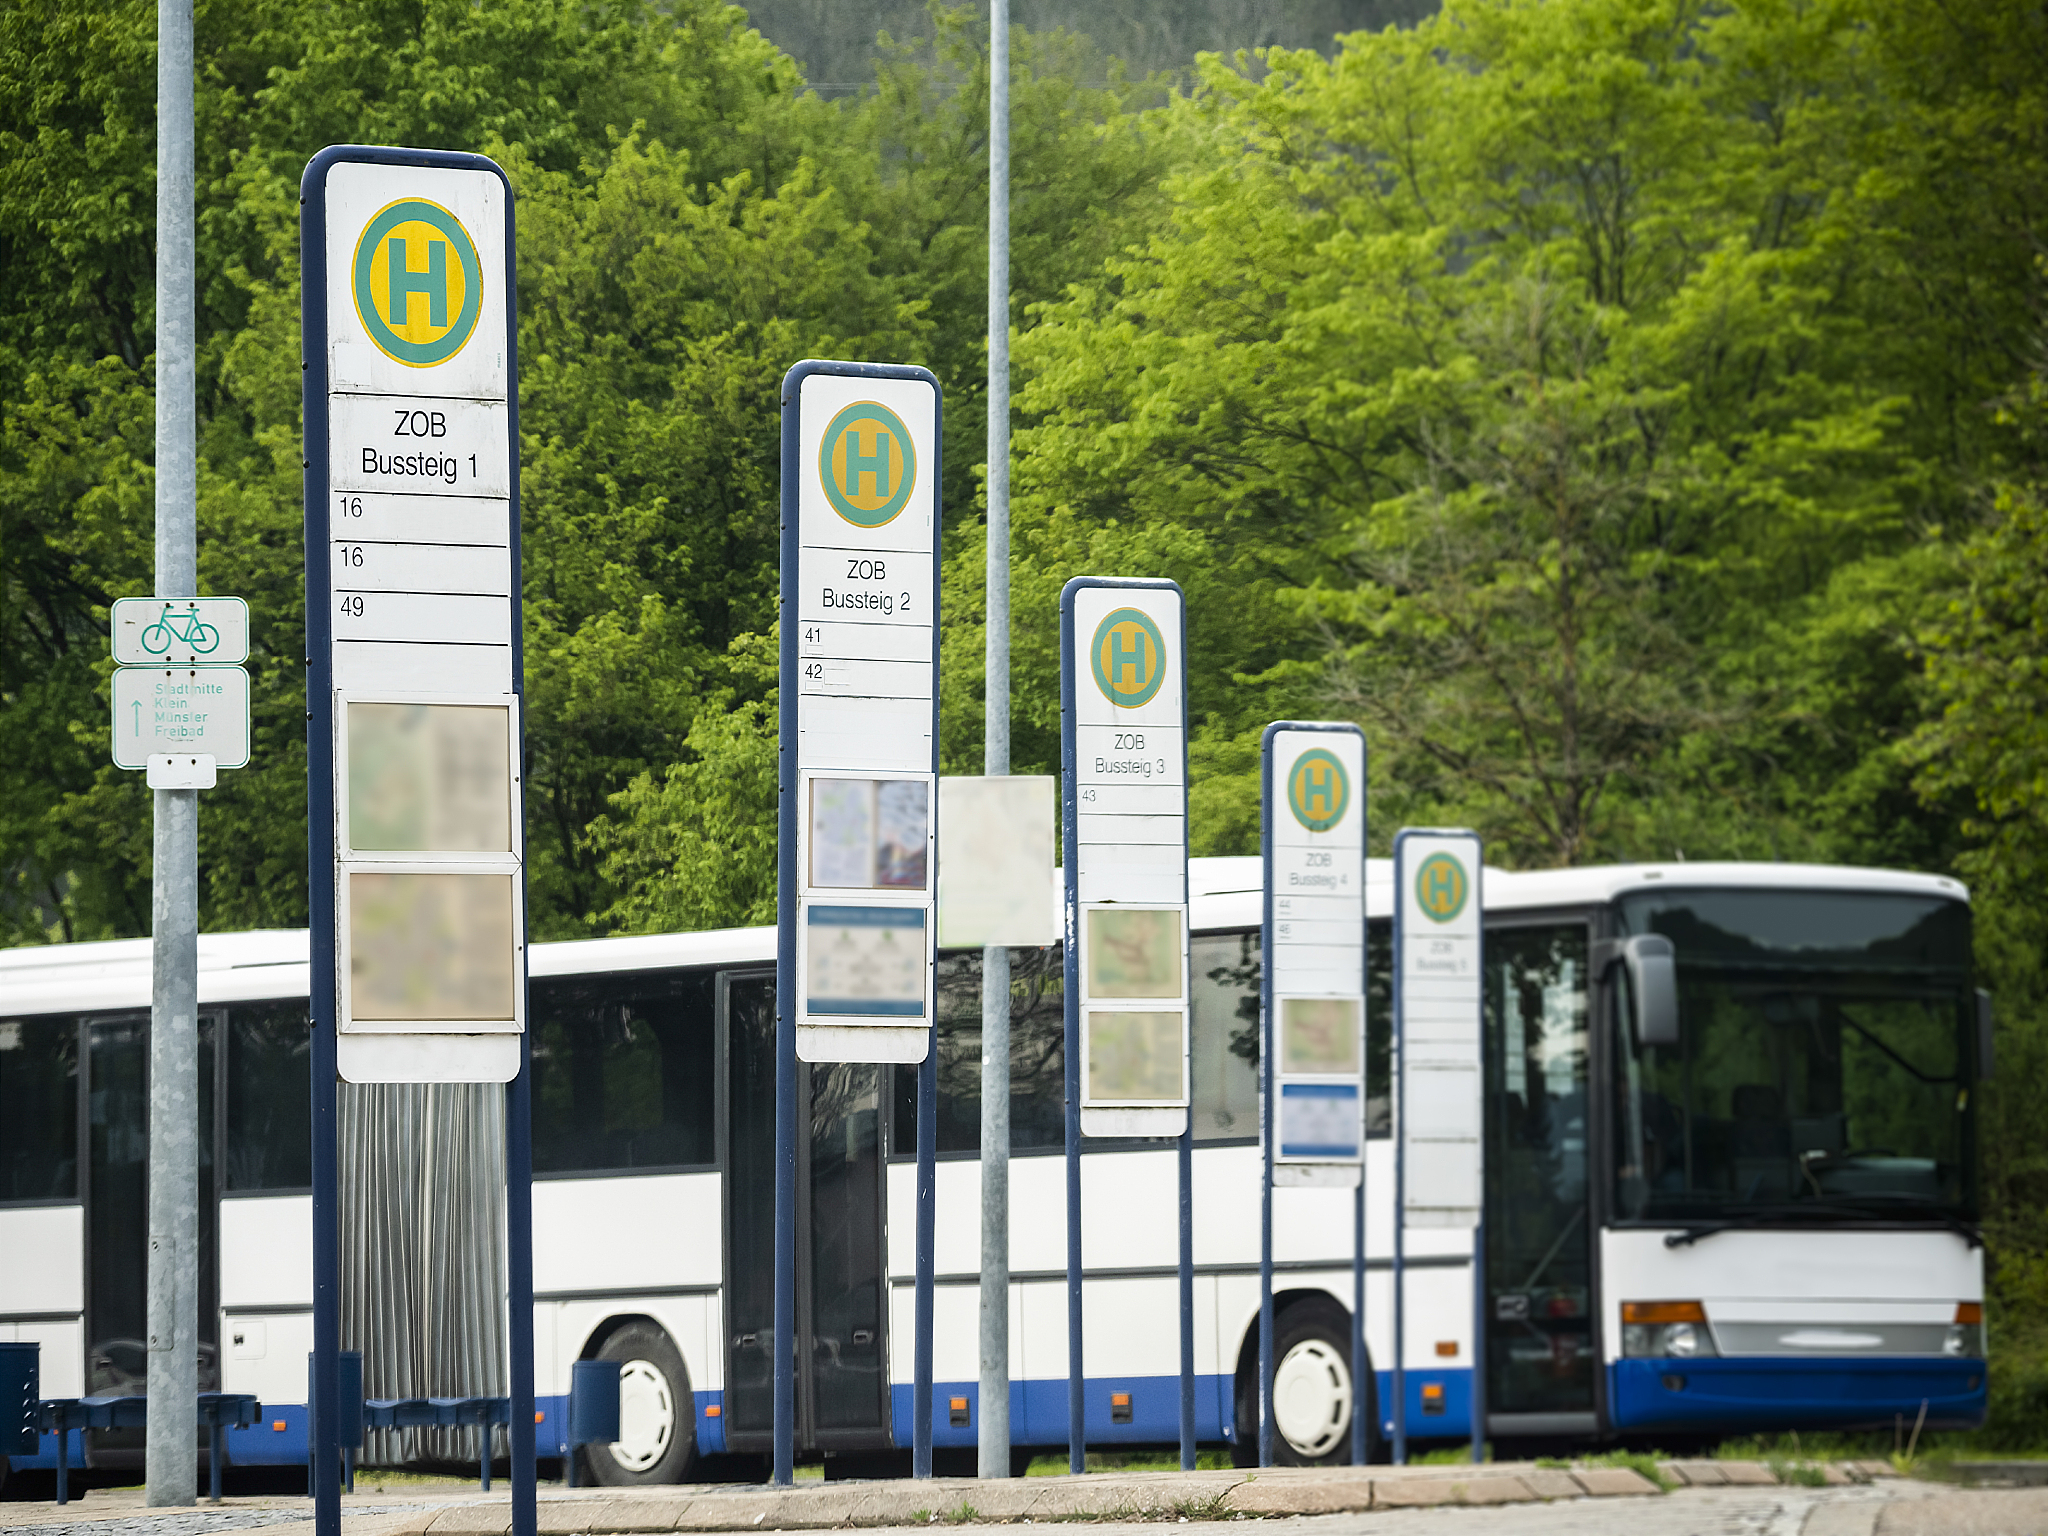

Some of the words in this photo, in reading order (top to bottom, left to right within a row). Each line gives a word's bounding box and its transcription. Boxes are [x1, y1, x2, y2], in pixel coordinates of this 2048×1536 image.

[388, 237, 448, 328] H
[394, 410, 447, 438] ZOB
[361, 447, 458, 485] Bussteig
[468, 452, 478, 479] 1
[845, 430, 890, 497] H
[339, 496, 363, 518] 16
[340, 546, 364, 568] 16
[847, 559, 886, 580] ZOB
[340, 595, 364, 618] 49
[822, 587, 893, 616] Bussteig
[900, 591, 911, 611] 2
[804, 627, 821, 643] 41
[1111, 631, 1146, 684] H
[804, 663, 823, 679] 42
[154, 697, 188, 709] Klein
[154, 725, 204, 737] Freibad
[1114, 733, 1145, 750] ZOB
[1095, 757, 1152, 778] Bussteig
[1156, 758, 1165, 774] 3
[1081, 789, 1096, 802] 43
[1304, 767, 1334, 813] H
[1305, 852, 1332, 868] ZOB
[1289, 872, 1337, 890] Bussteig
[1429, 868, 1455, 906] H
